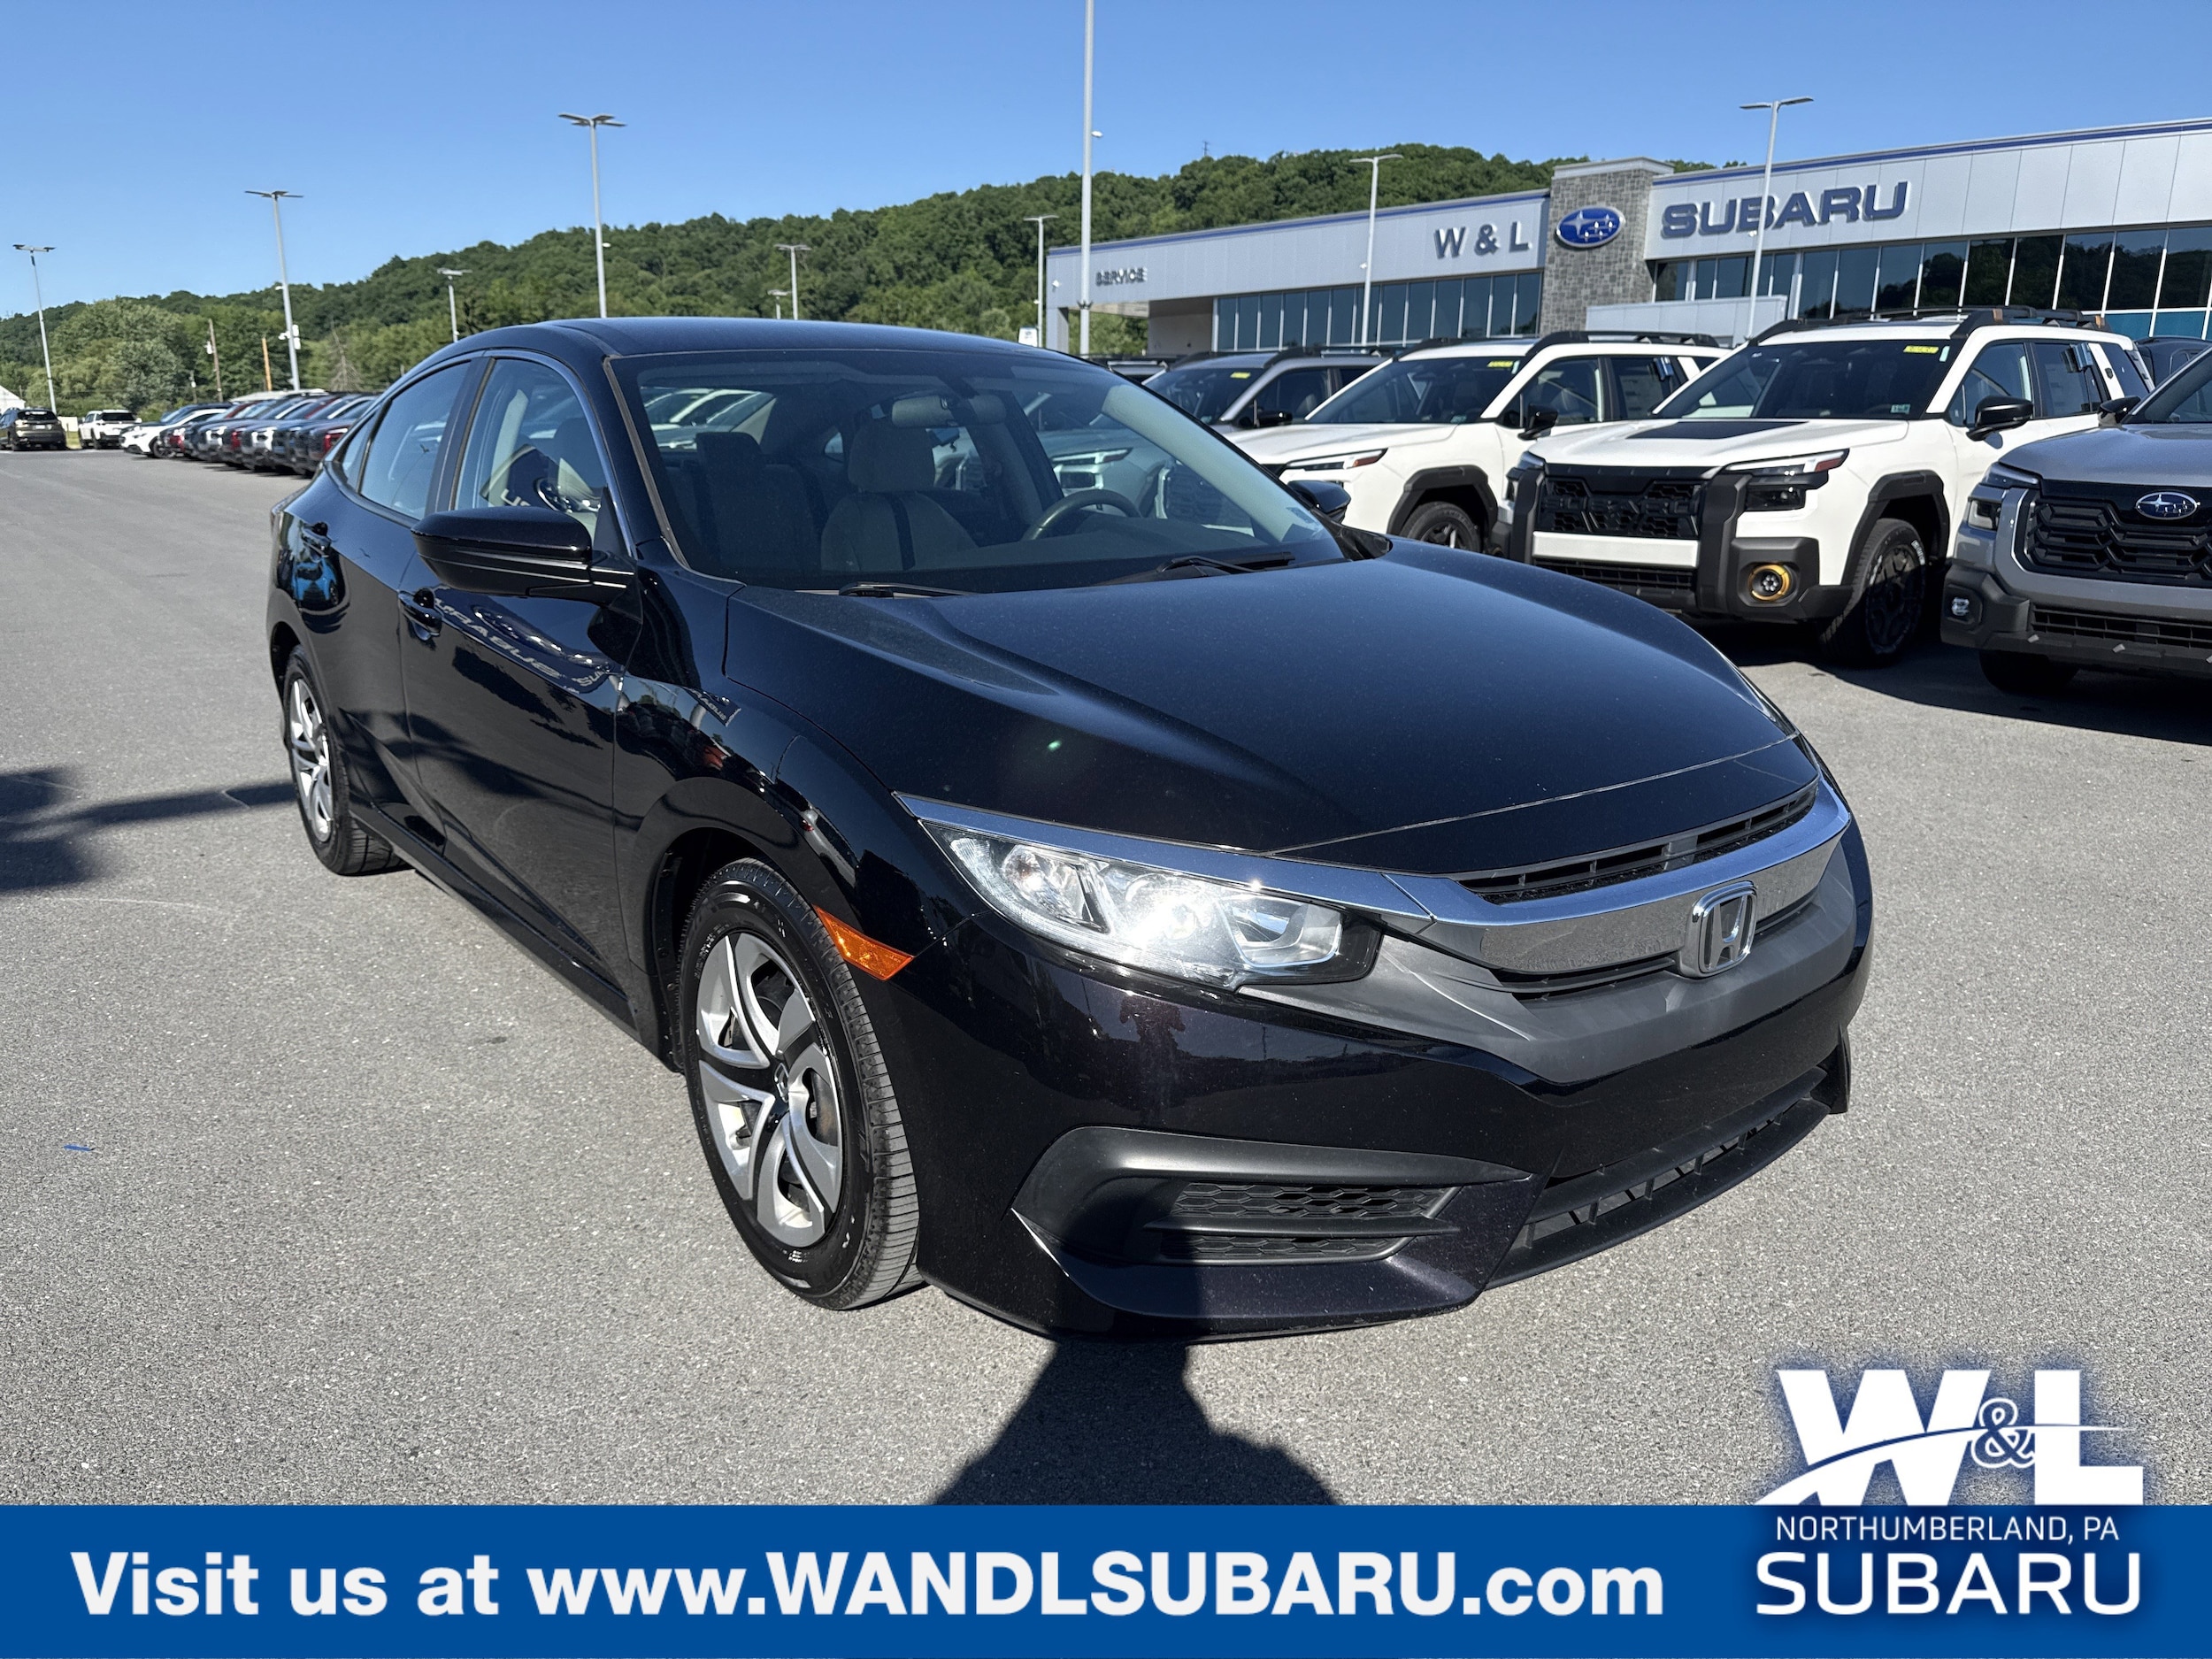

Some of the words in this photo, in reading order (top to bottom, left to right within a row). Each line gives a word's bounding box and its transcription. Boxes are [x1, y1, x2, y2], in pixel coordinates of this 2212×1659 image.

[1662, 181, 1909, 239] SUBARU
[1433, 227, 1467, 259] W
[1474, 224, 1500, 256] &
[1509, 221, 1532, 253] L
[1095, 267, 1147, 287] SERVICE
